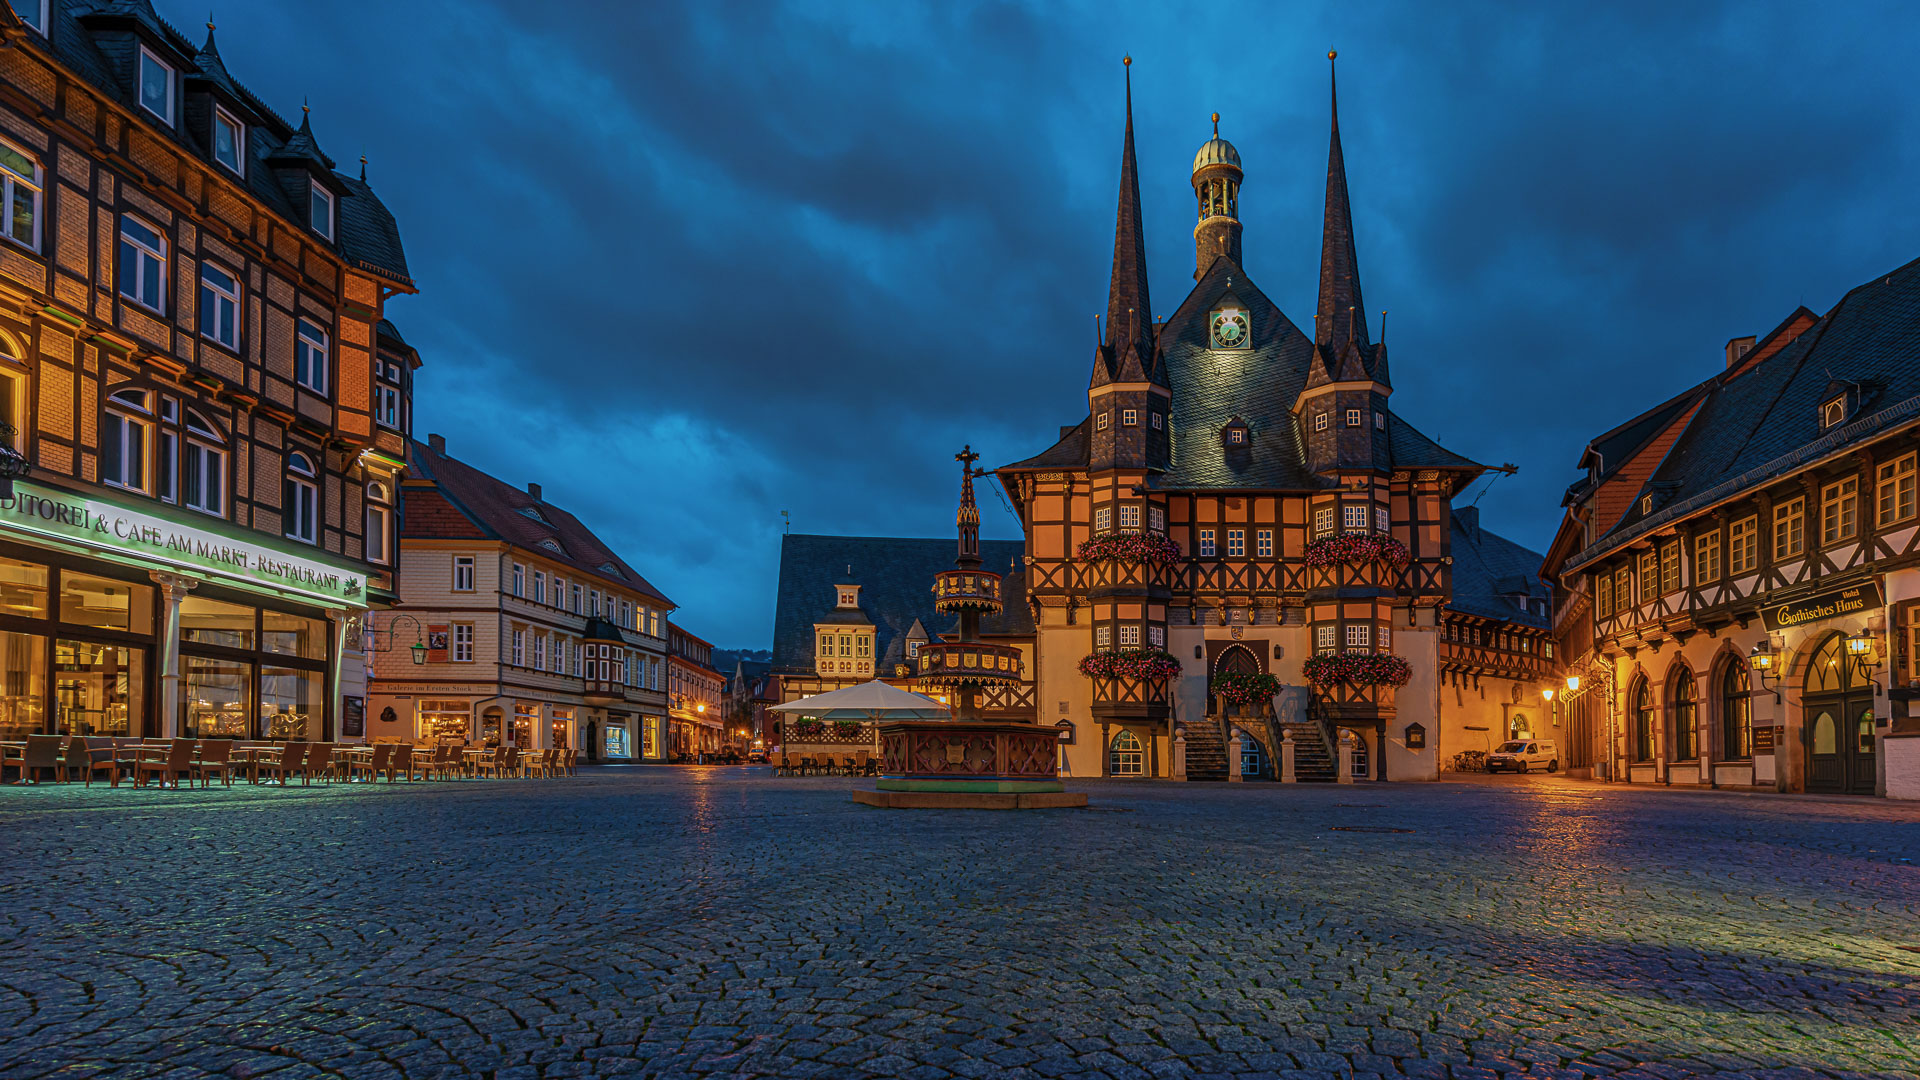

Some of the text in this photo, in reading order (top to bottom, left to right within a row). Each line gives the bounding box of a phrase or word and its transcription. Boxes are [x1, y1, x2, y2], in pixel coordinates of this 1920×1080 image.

[95, 513, 110, 534] &
[166, 532, 193, 555] AM
[196, 539, 250, 569] MARKT
[258, 553, 340, 590] RESTAURANT
[1842, 589, 1860, 599] Hotel
[1778, 599, 1863, 625] Gothisches Haus
